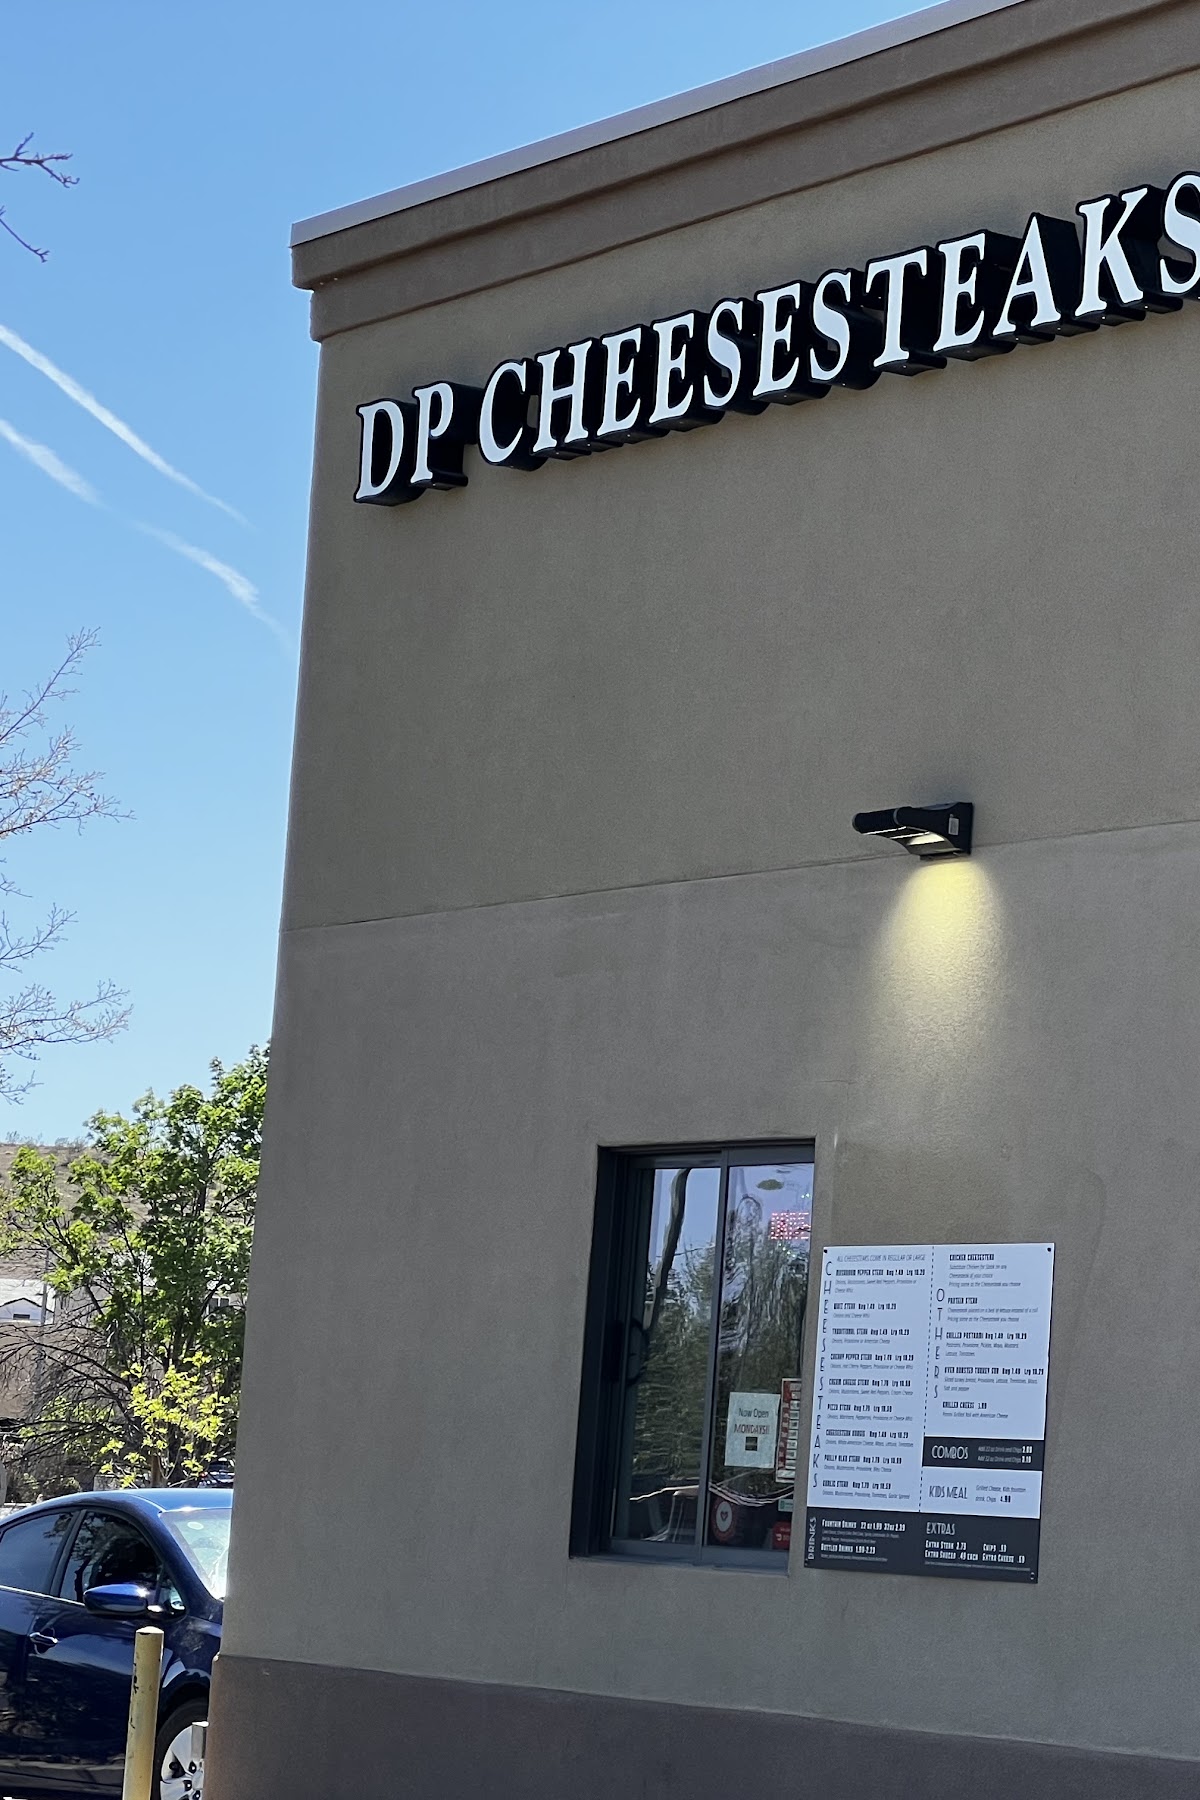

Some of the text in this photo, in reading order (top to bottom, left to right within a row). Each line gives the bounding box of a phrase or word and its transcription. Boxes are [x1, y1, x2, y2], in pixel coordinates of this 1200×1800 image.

[355, 382, 454, 500] DP
[738, 1408, 770, 1418] Now Open
[931, 1445, 969, 1460] COMBOS
[928, 1485, 968, 1499] KIDS MEAL
[926, 1522, 955, 1536] EXTRAS
[807, 1516, 817, 1560] DRINKS
